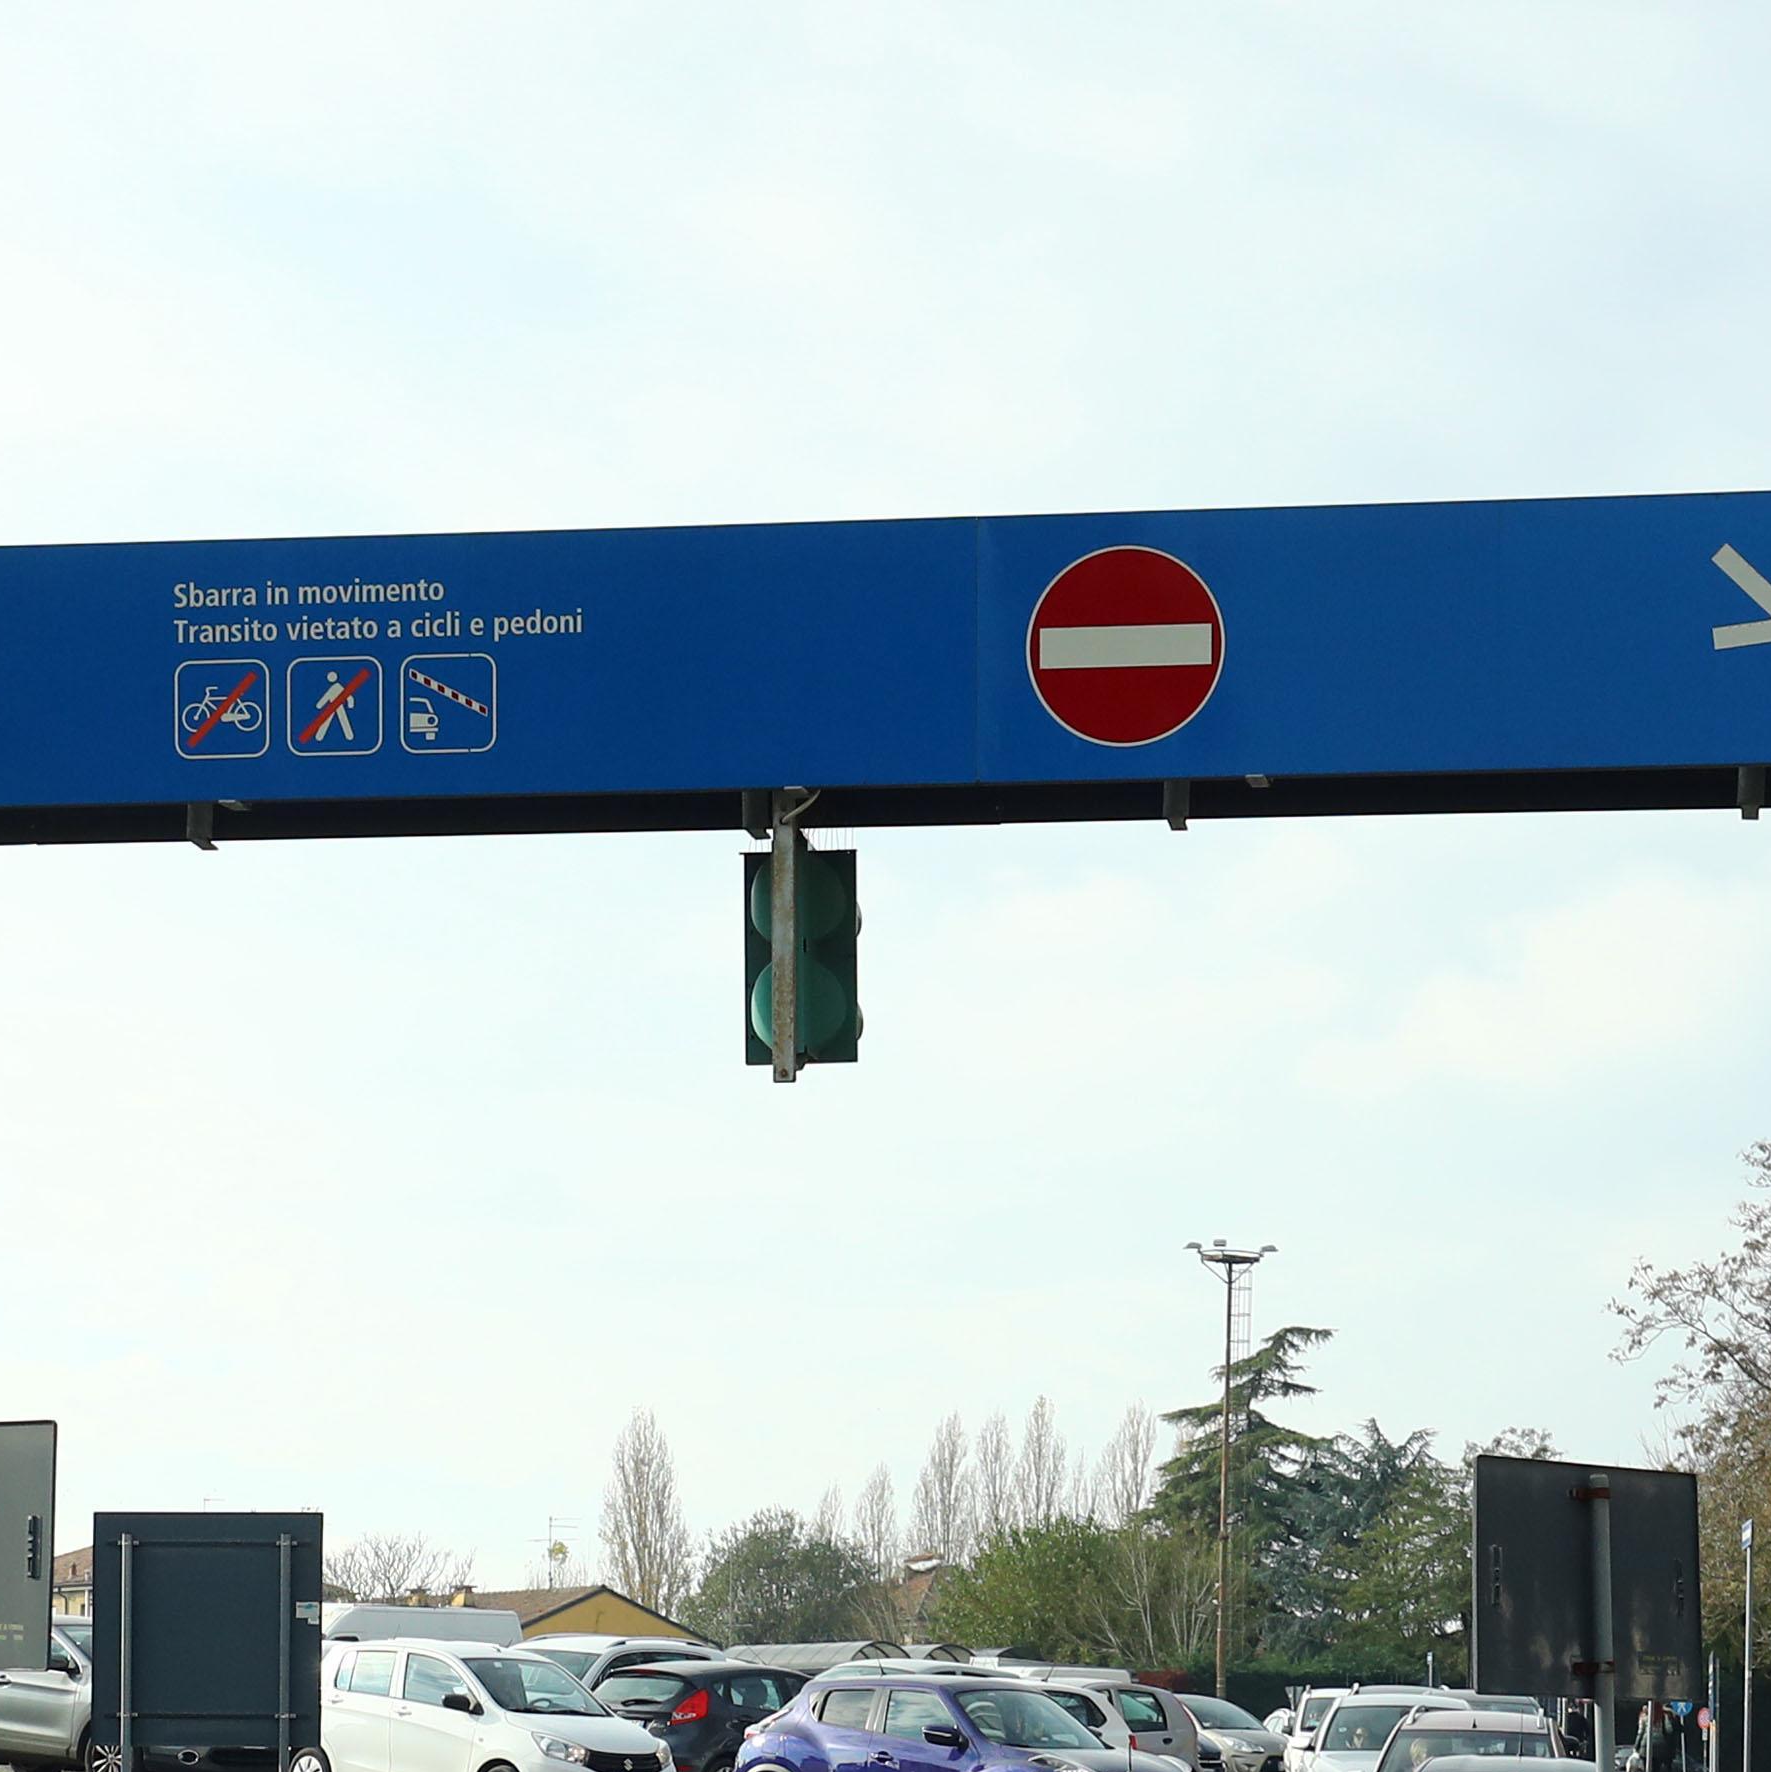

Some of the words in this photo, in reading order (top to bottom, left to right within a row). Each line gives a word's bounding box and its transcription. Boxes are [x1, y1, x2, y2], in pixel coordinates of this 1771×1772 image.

[173, 582, 256, 608] Sbarra
[267, 581, 289, 605] in
[298, 578, 444, 604] movimento
[173, 617, 278, 643] Transito
[287, 614, 378, 641] vietato
[387, 616, 402, 638] a
[410, 611, 460, 638] cicli
[469, 615, 484, 636] e
[493, 608, 583, 642] pedoni
